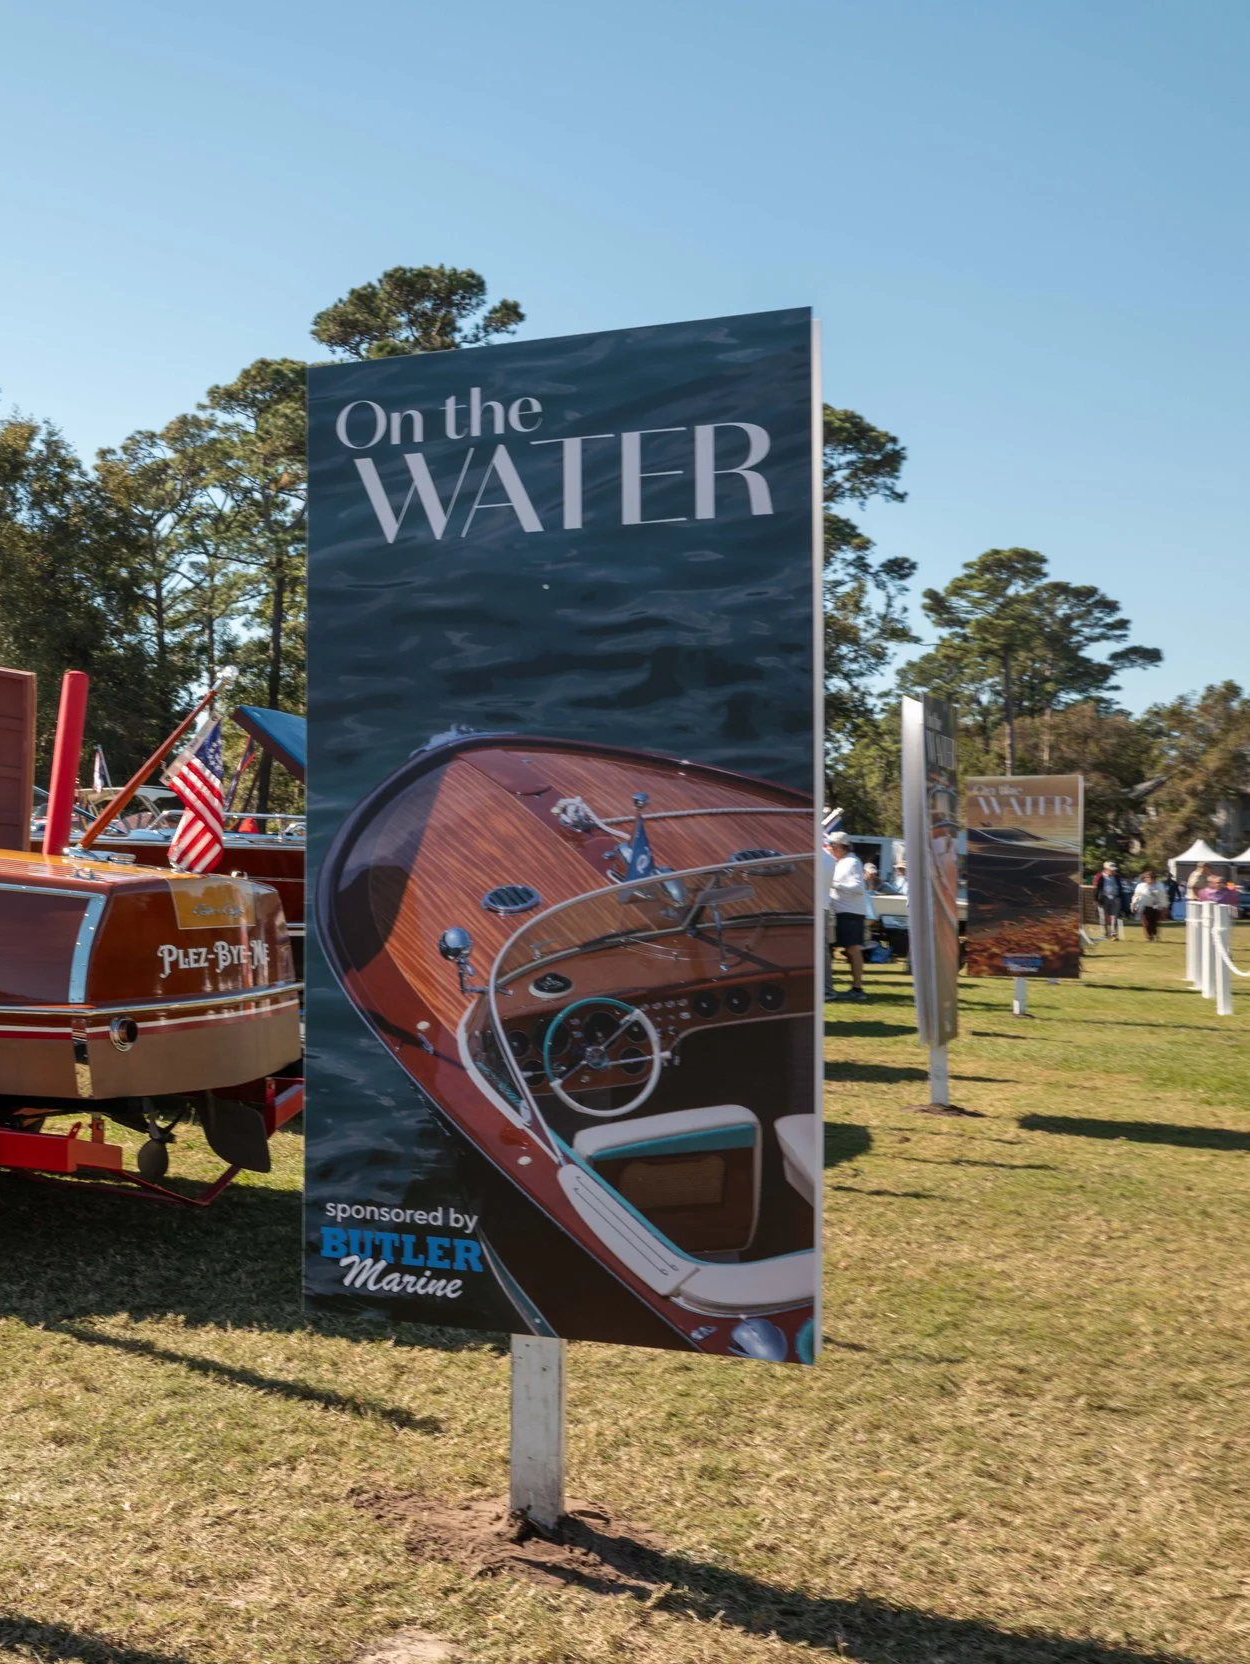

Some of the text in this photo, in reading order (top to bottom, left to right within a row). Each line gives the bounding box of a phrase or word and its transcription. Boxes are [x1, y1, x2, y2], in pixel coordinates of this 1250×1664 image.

[336, 387, 543, 449] On the
[354, 422, 774, 543] WATER
[977, 796, 1073, 817] WATER
[325, 1202, 479, 1234] sponsored by
[319, 1226, 485, 1272] BUTLER
[339, 1255, 463, 1298] Marine
